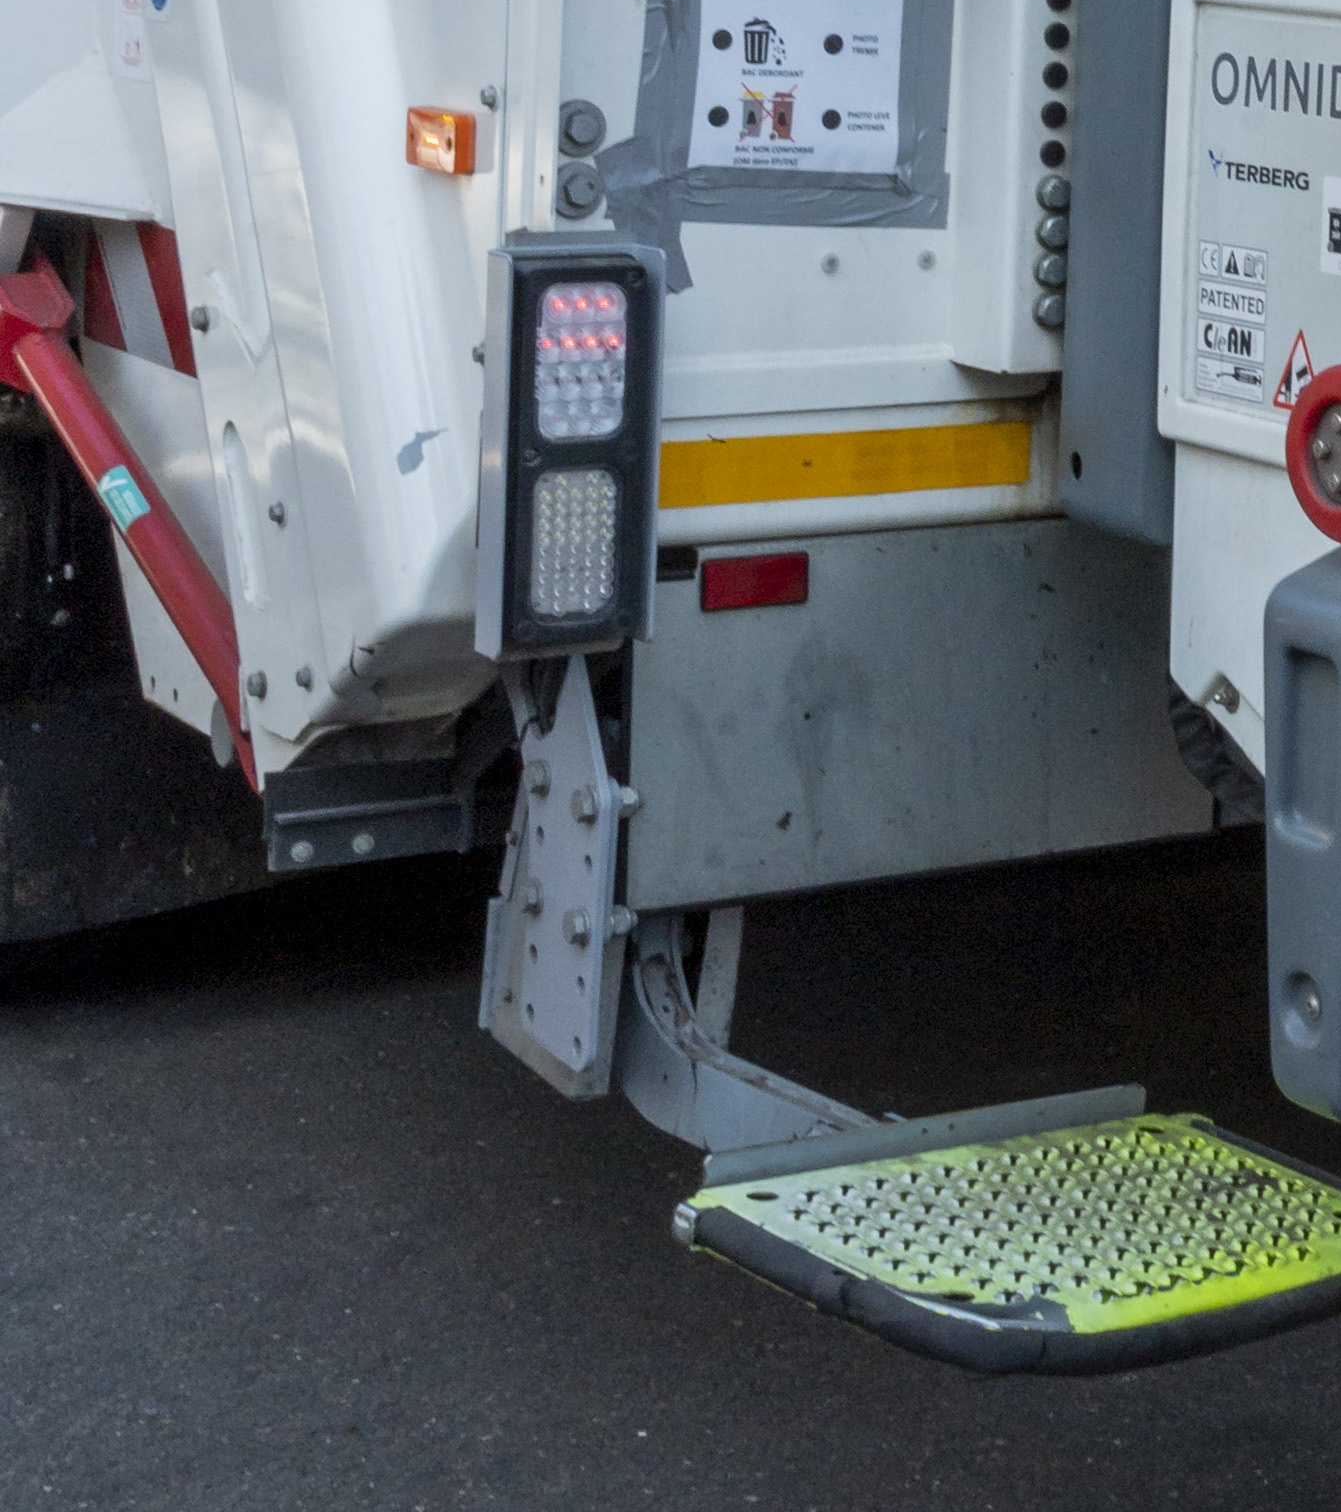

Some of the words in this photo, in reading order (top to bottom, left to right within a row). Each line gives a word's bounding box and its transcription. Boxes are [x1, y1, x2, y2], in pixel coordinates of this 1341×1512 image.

[852, 35, 879, 43] PHOTO
[742, 68, 757, 77] BAC
[847, 111, 873, 120] PHOTO
[735, 145, 749, 154] BAC
[752, 145, 770, 154] NON
[771, 146, 815, 155] CONFORME
[1224, 161, 1310, 191] TERBERG
[1200, 287, 1265, 316] PATENTED
